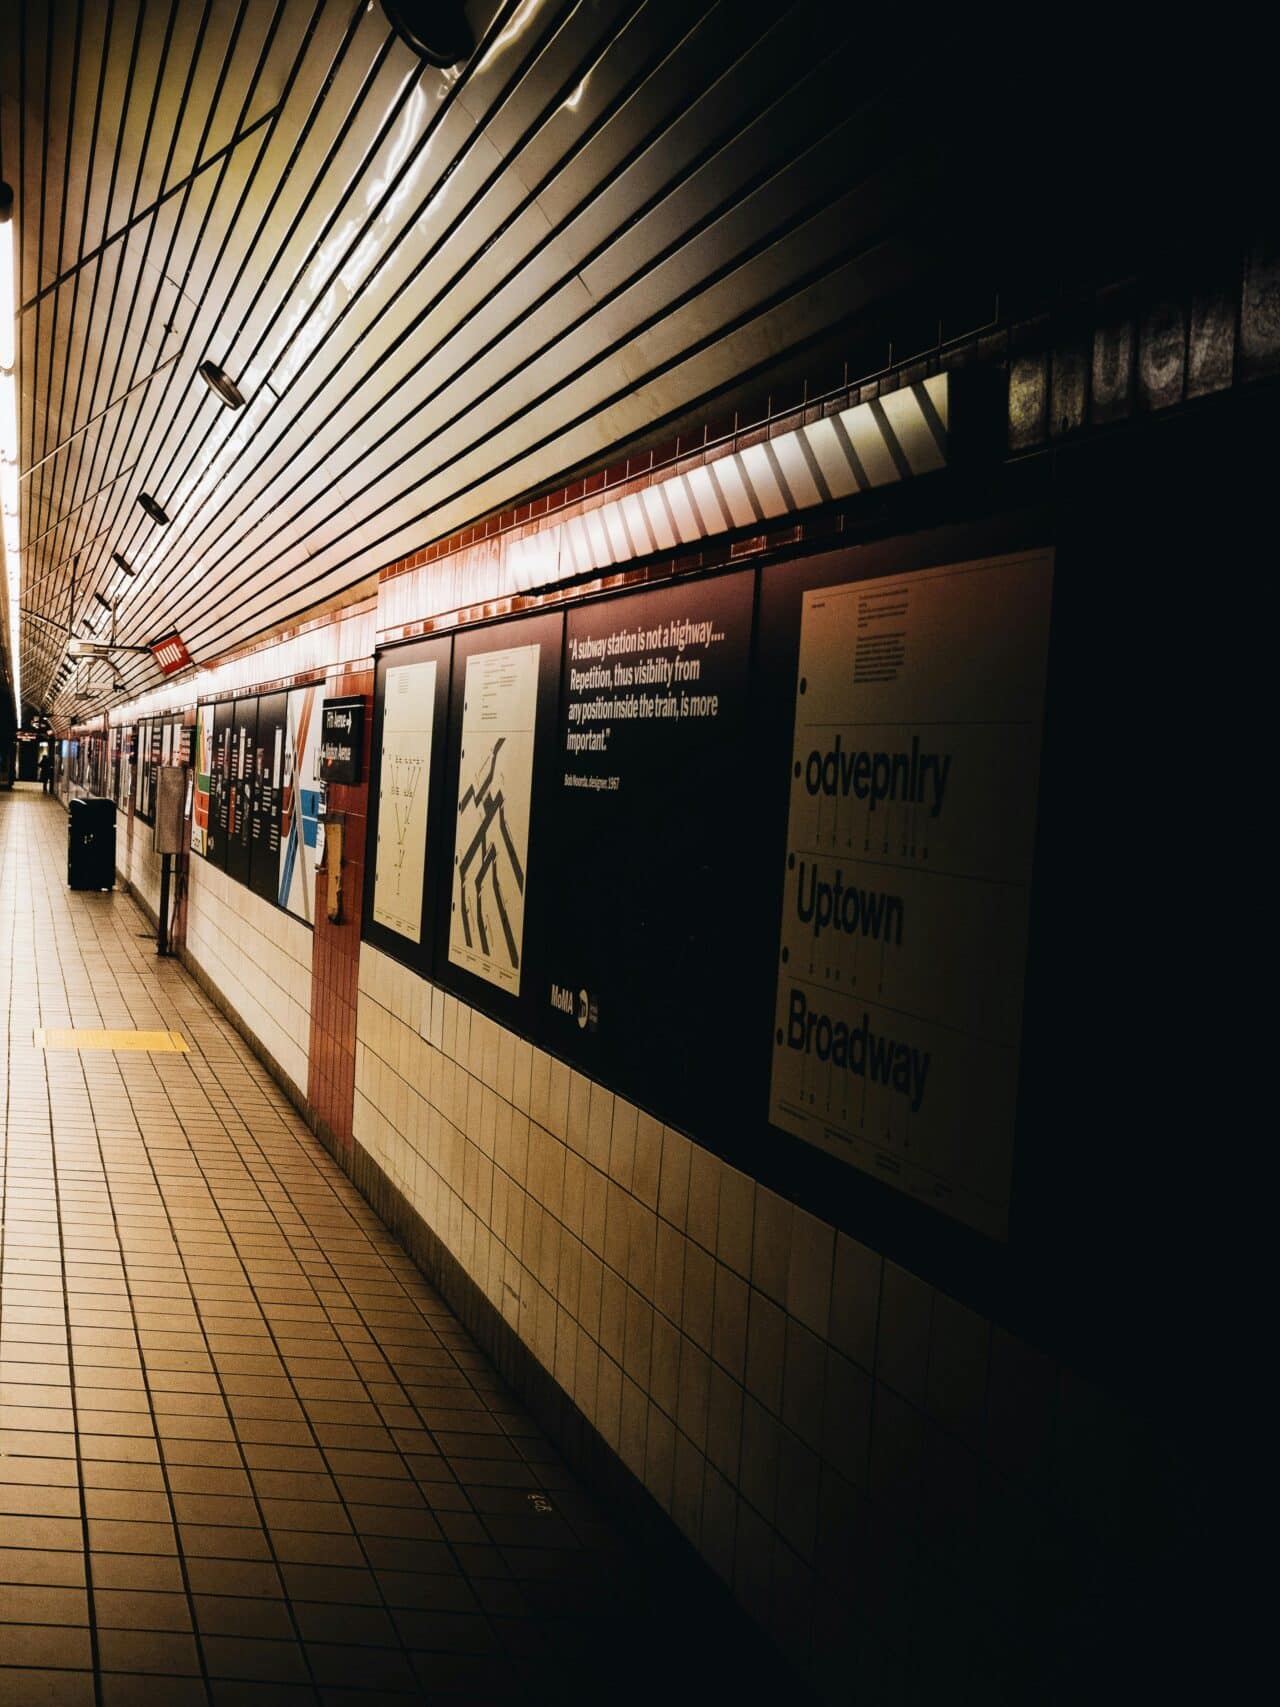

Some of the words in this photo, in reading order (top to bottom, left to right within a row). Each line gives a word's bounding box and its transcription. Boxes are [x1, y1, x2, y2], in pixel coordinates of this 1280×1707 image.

[578, 636, 607, 662] subway
[607, 629, 637, 655] station
[637, 627, 645, 651] is
[646, 624, 662, 650] not
[663, 628, 669, 648] a
[570, 664, 612, 695] Repetition,
[614, 662, 633, 687] thus
[634, 657, 673, 688] visibility
[675, 655, 700, 681] from
[568, 703, 582, 725] any
[582, 696, 613, 725] position
[614, 694, 638, 719] inside
[639, 693, 654, 718] the
[655, 690, 679, 722] train,
[680, 690, 689, 717] is
[690, 695, 718, 717] more
[806, 735, 952, 817] odvepnlry
[797, 862, 904, 944] Uptown
[787, 990, 930, 1112] Broadway
